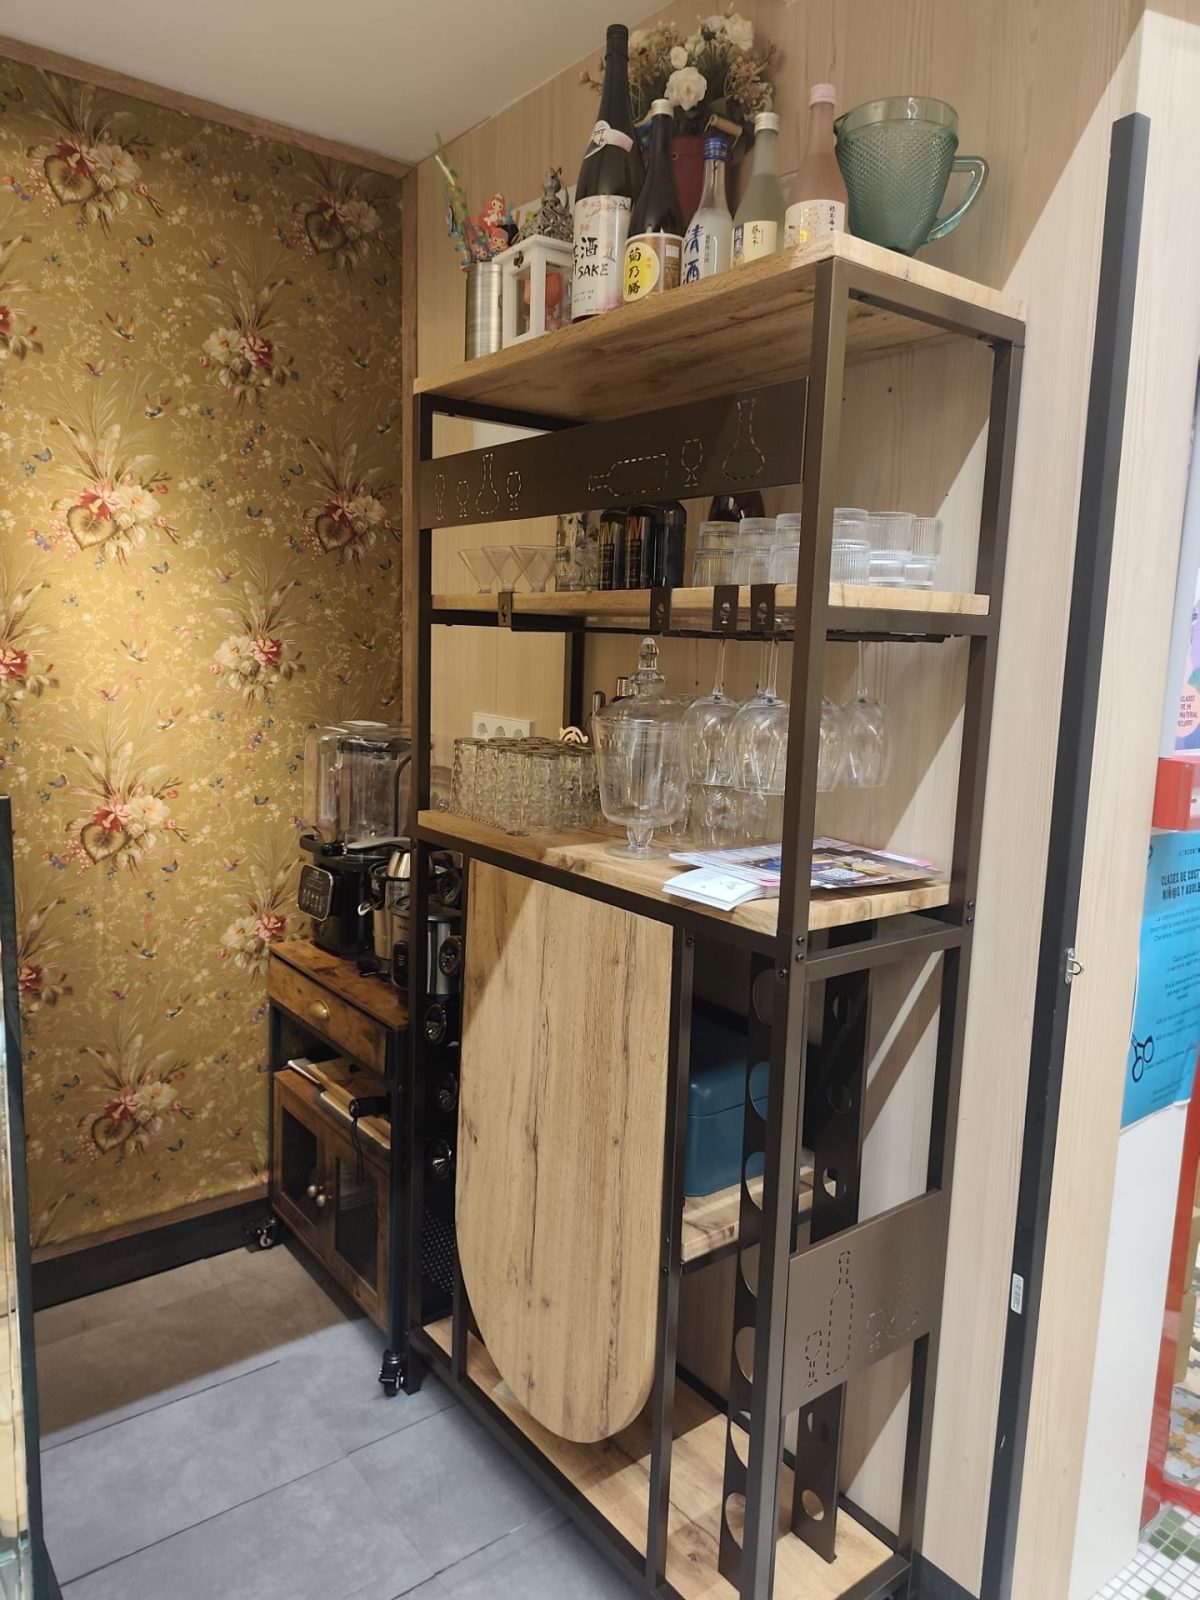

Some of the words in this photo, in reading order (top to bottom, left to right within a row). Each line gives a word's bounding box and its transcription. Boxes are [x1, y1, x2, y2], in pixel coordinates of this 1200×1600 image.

[580, 236, 598, 259] 酒
[578, 263, 609, 279] SAKE
[1161, 872, 1179, 886] CLASES
[1180, 870, 1187, 882] DE
